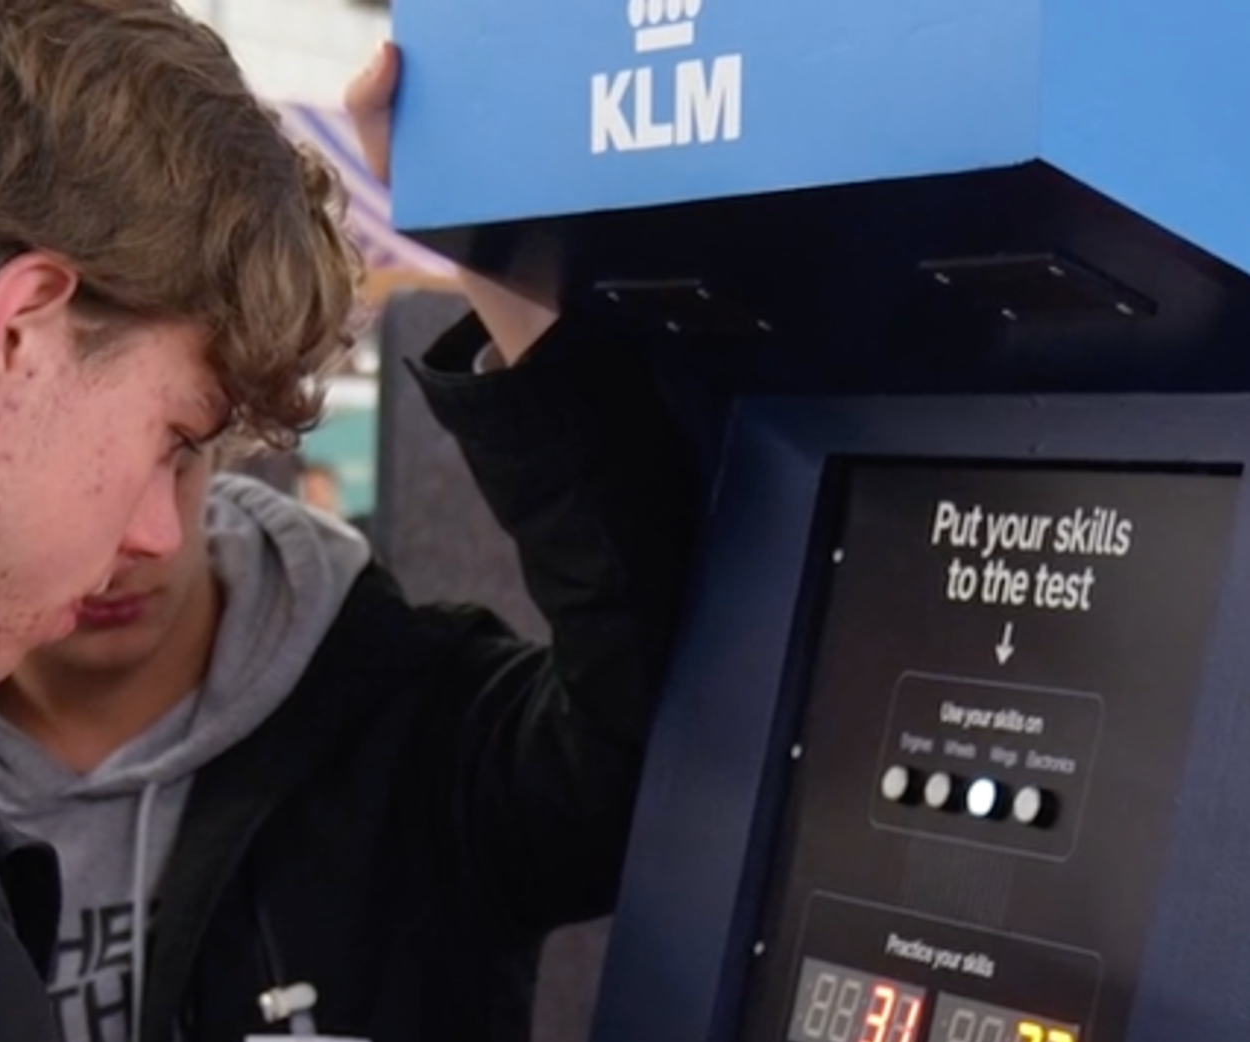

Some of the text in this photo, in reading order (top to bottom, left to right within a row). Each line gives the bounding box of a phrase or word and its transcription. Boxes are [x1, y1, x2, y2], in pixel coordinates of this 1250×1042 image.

[591, 54, 742, 154] KLM
[931, 500, 1133, 558] Put your skills
[947, 556, 1094, 611] to the test
[963, 709, 993, 730] your
[992, 709, 1023, 733] skills
[1024, 715, 1044, 734] on
[885, 933, 995, 978] Practice your skills
